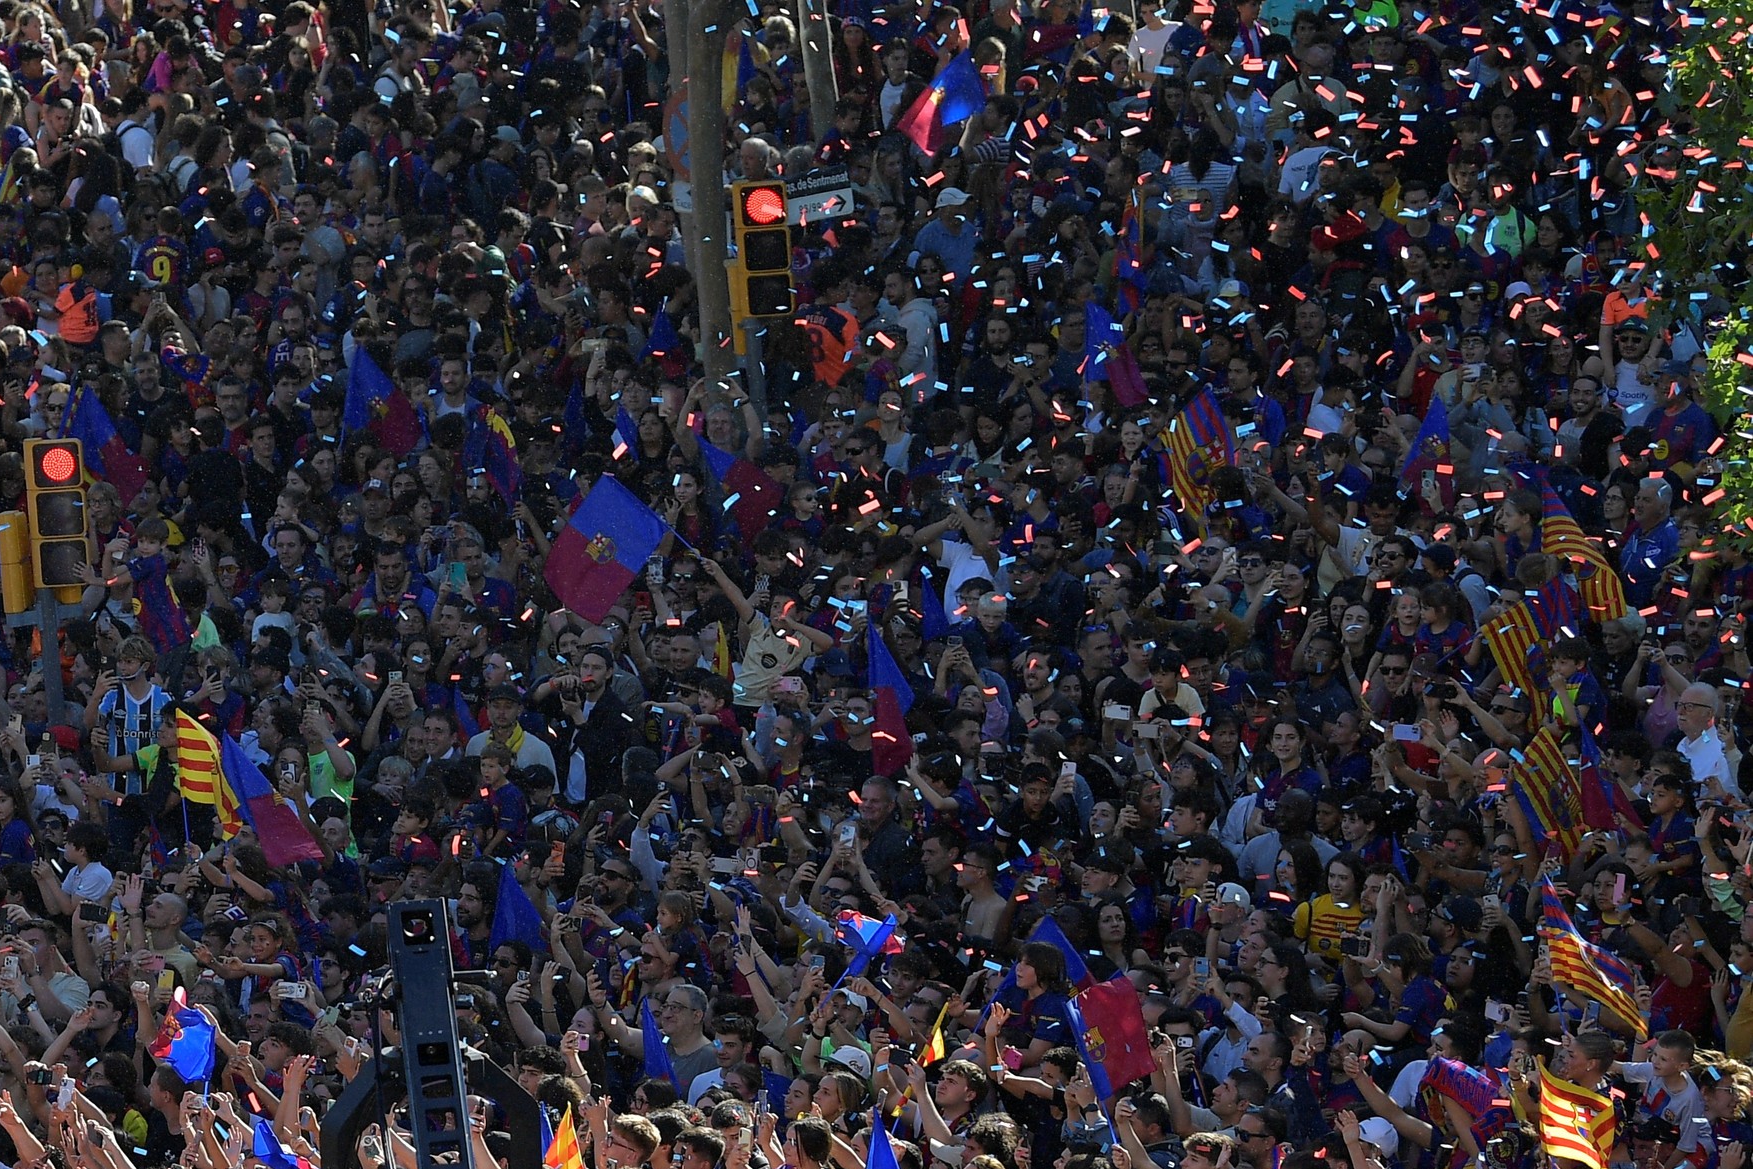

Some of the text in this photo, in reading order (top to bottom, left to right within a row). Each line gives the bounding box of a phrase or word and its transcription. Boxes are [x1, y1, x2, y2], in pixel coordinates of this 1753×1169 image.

[797, 179, 807, 190] de
[807, 171, 849, 188] Sentmenat
[153, 256, 170, 284] 9
[1620, 391, 1648, 401] Spotify
